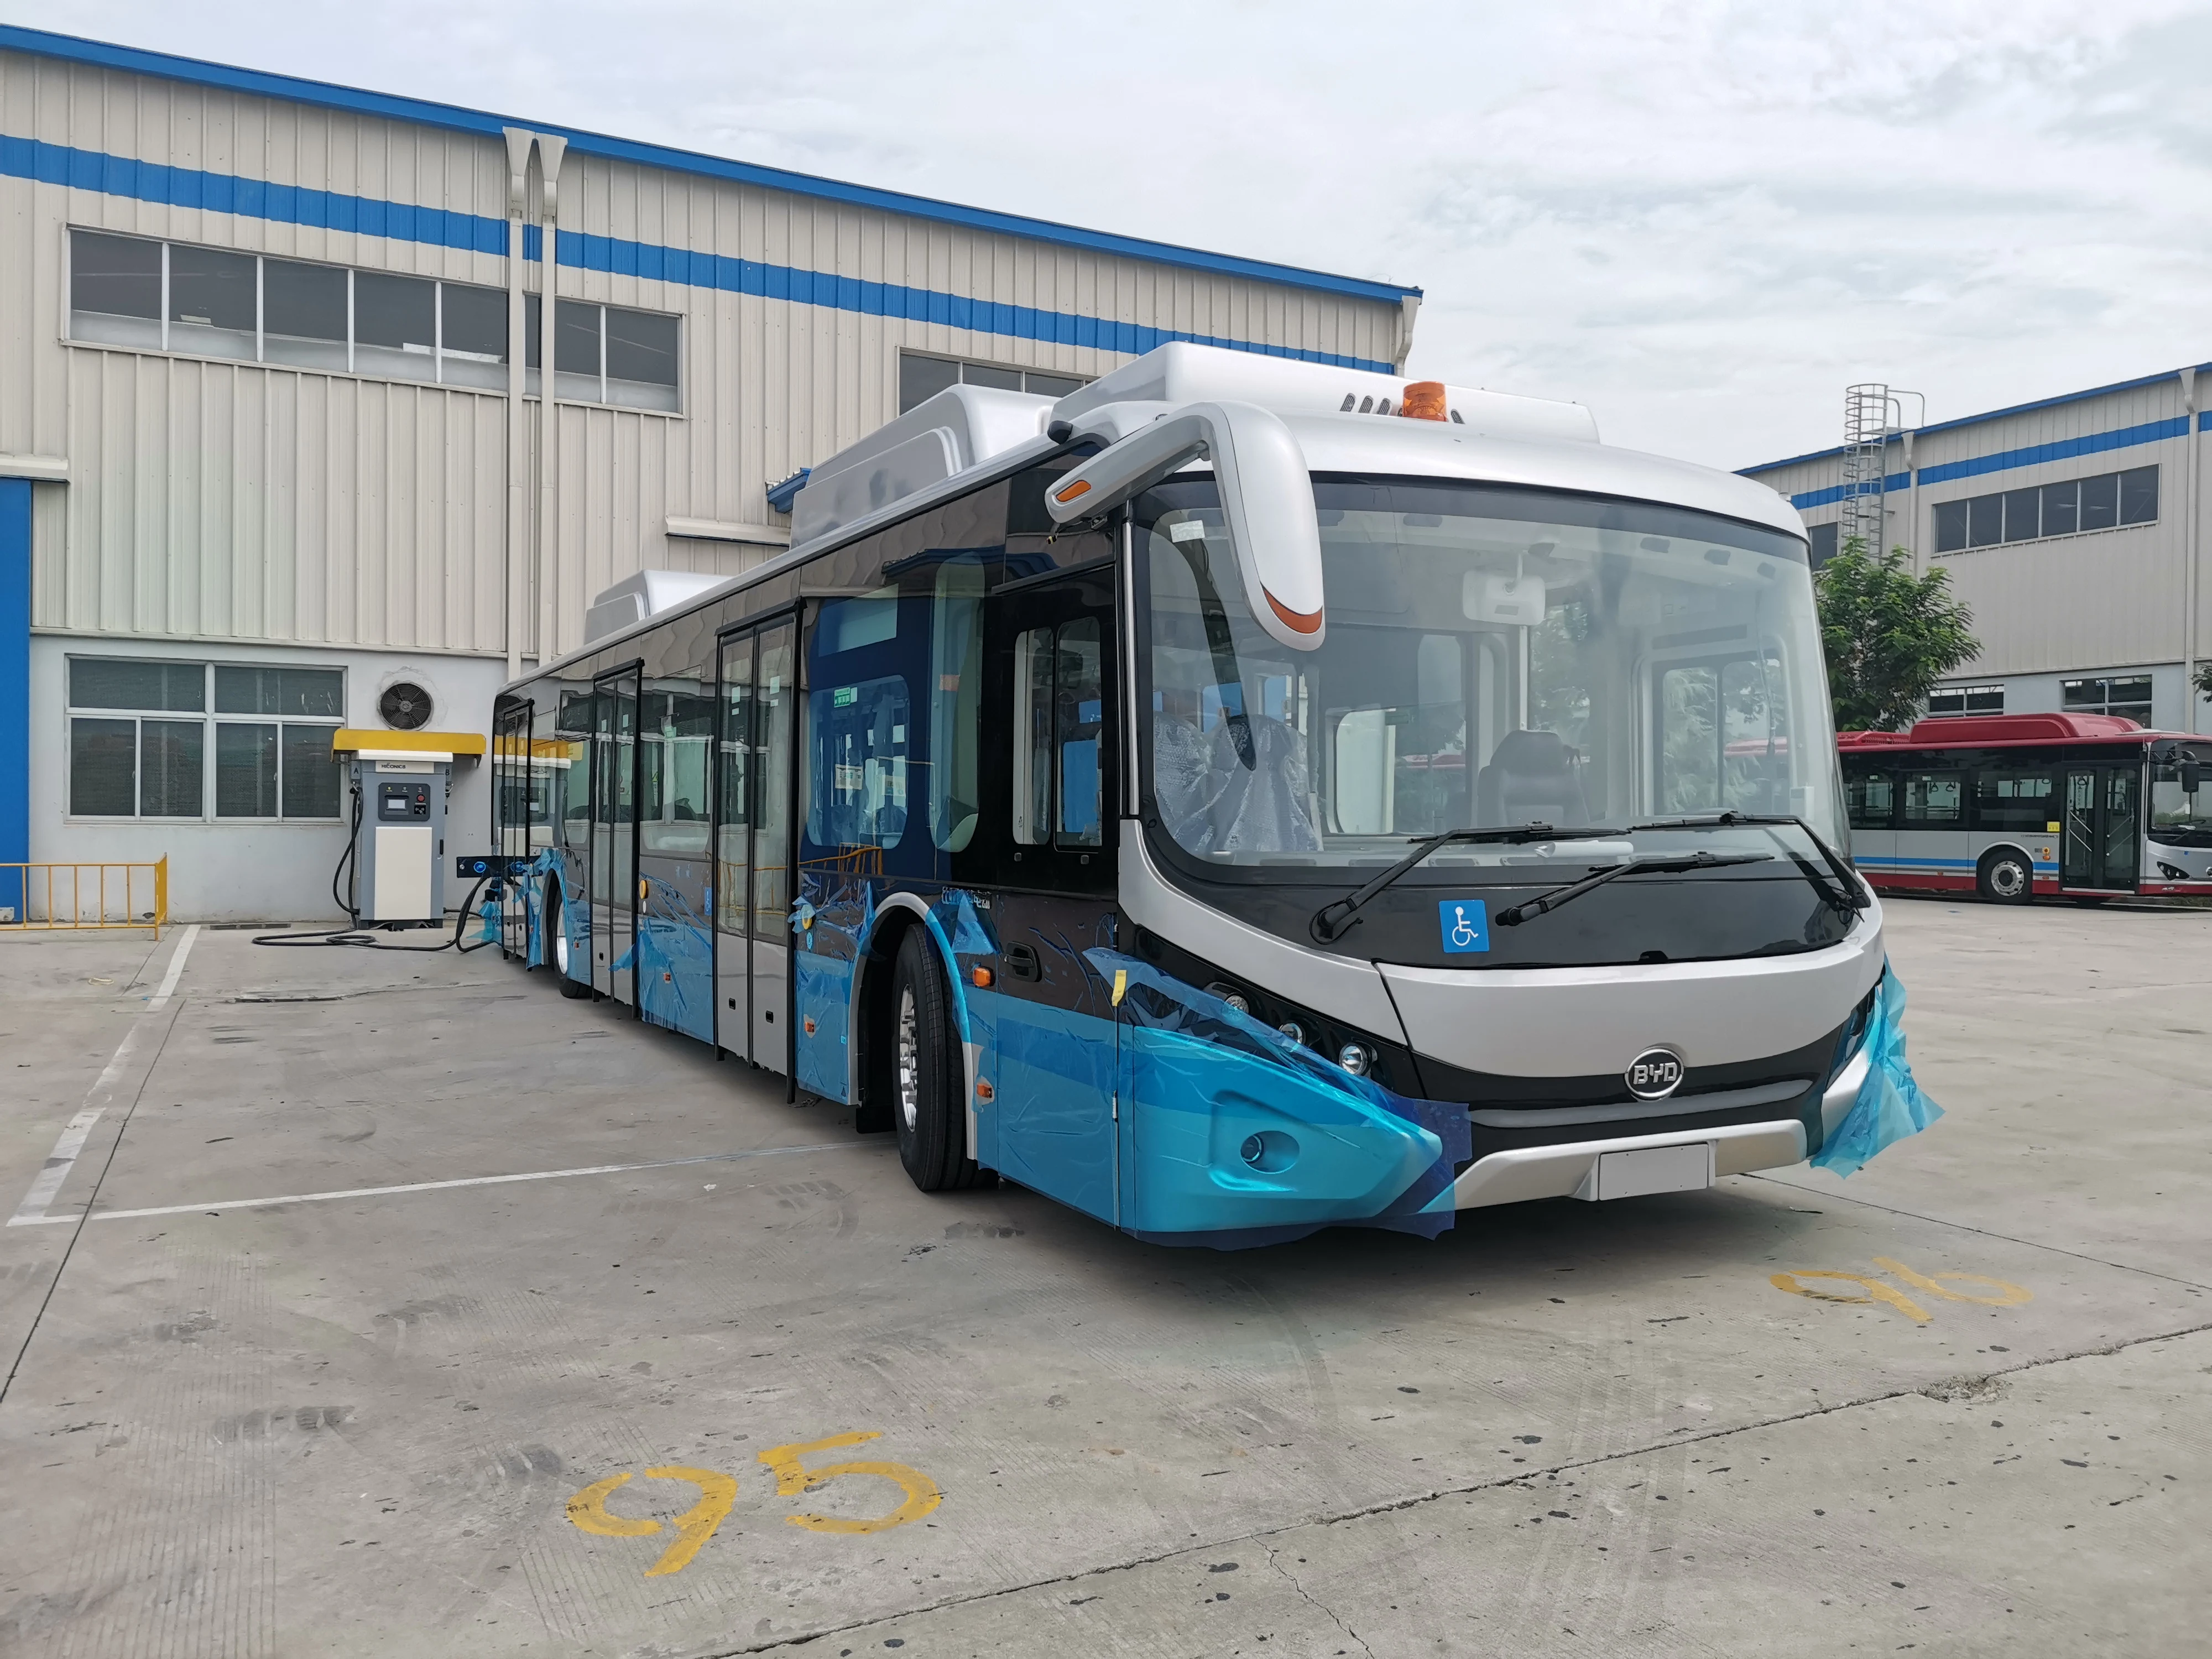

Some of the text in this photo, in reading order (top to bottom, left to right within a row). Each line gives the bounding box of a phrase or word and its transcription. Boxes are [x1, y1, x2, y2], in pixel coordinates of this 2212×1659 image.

[1633, 1062, 1678, 1085] BYD
[1770, 1256, 2034, 1324] 96
[565, 1431, 942, 1578] 95
